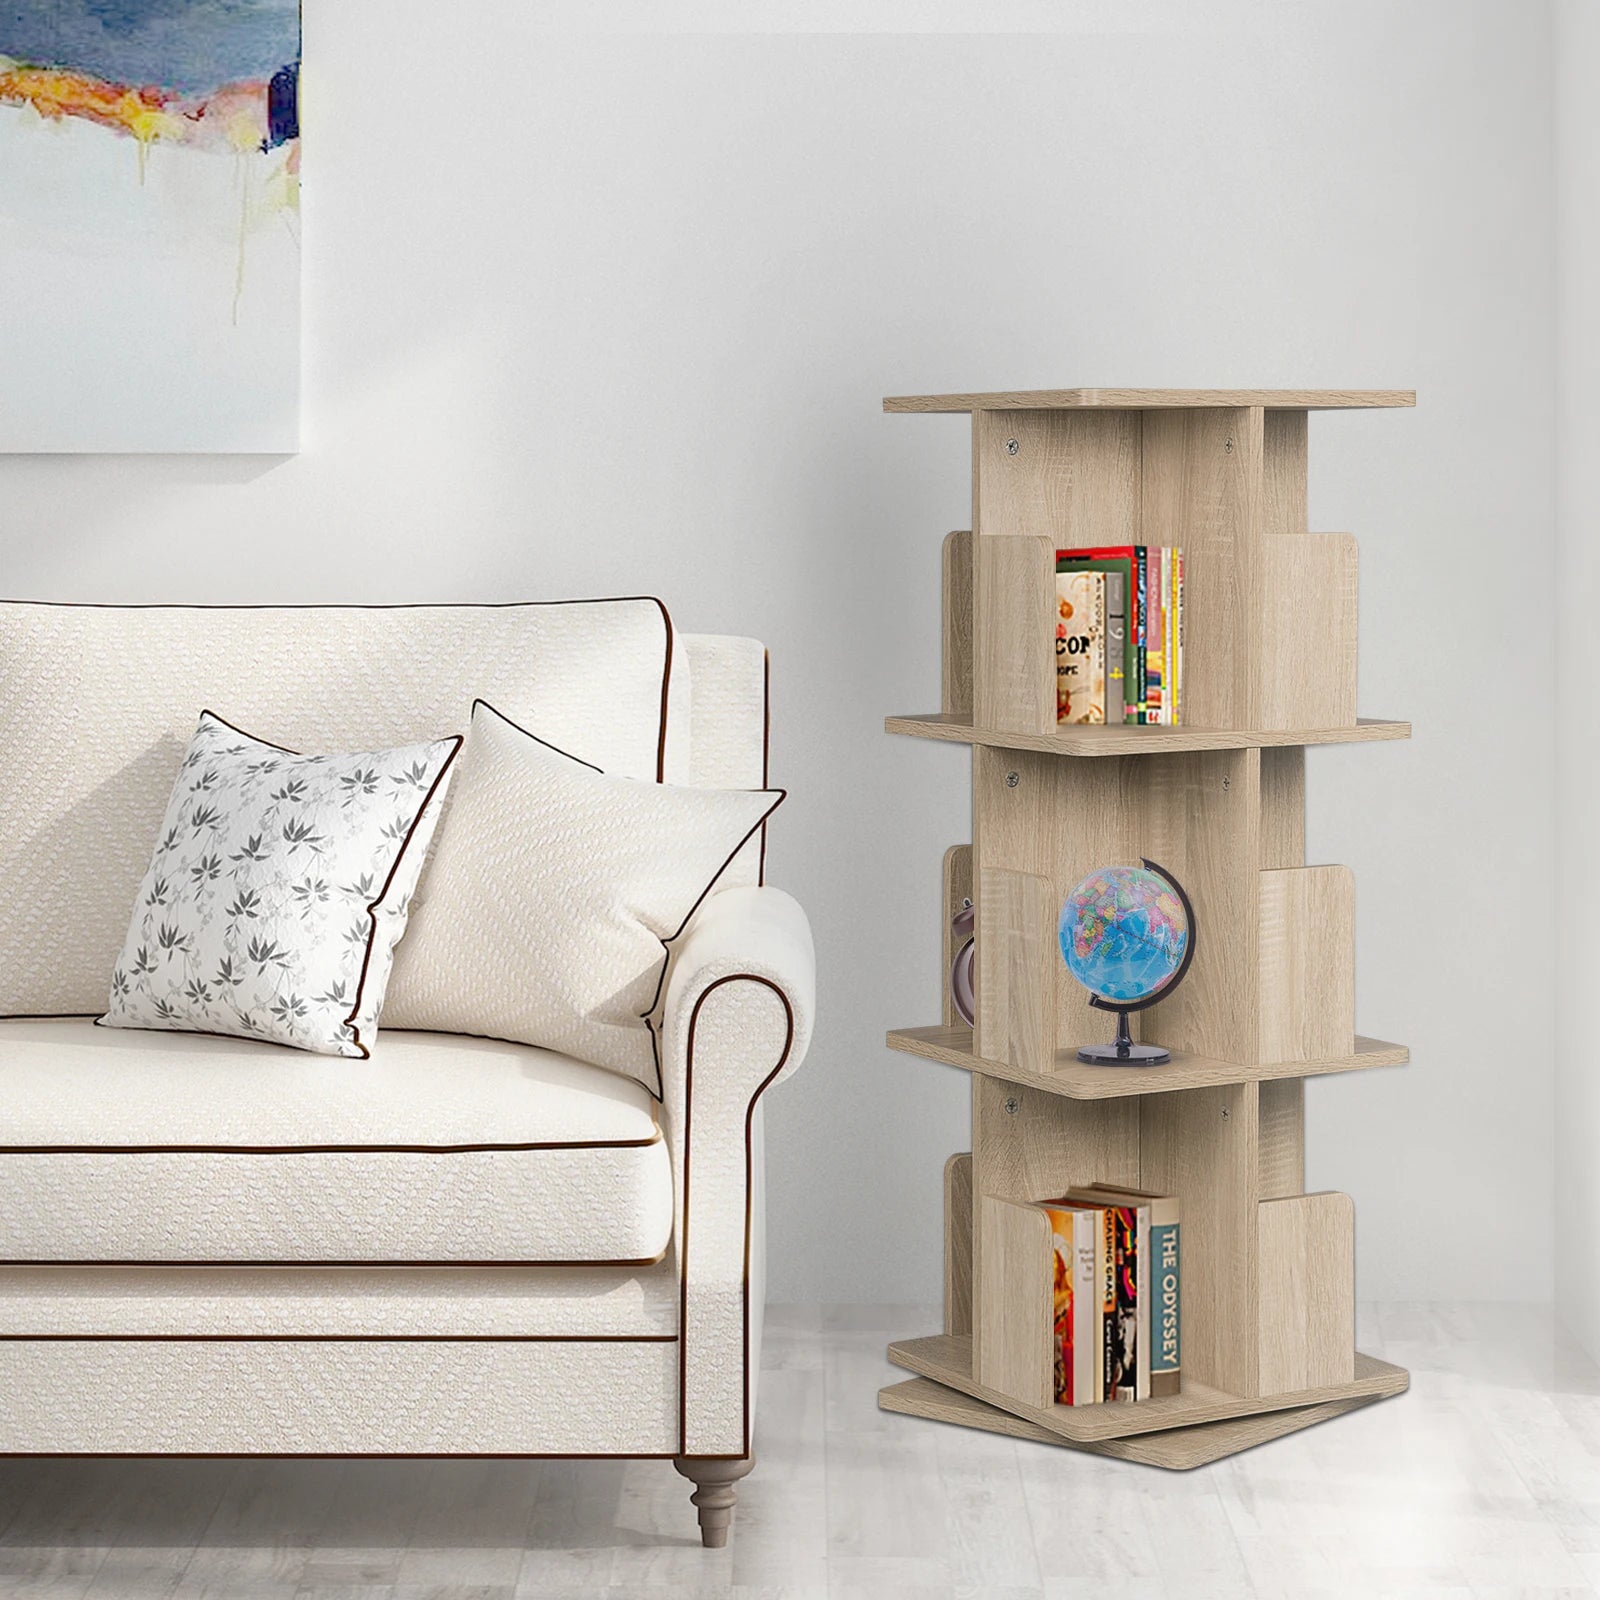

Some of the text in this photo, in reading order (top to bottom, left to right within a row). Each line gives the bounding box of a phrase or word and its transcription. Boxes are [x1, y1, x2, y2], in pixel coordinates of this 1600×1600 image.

[1109, 613, 1125, 681] 1984
[1105, 1208, 1114, 1305] CHASING GRACE
[1162, 1229, 1178, 1365] THE ODYSSEY
